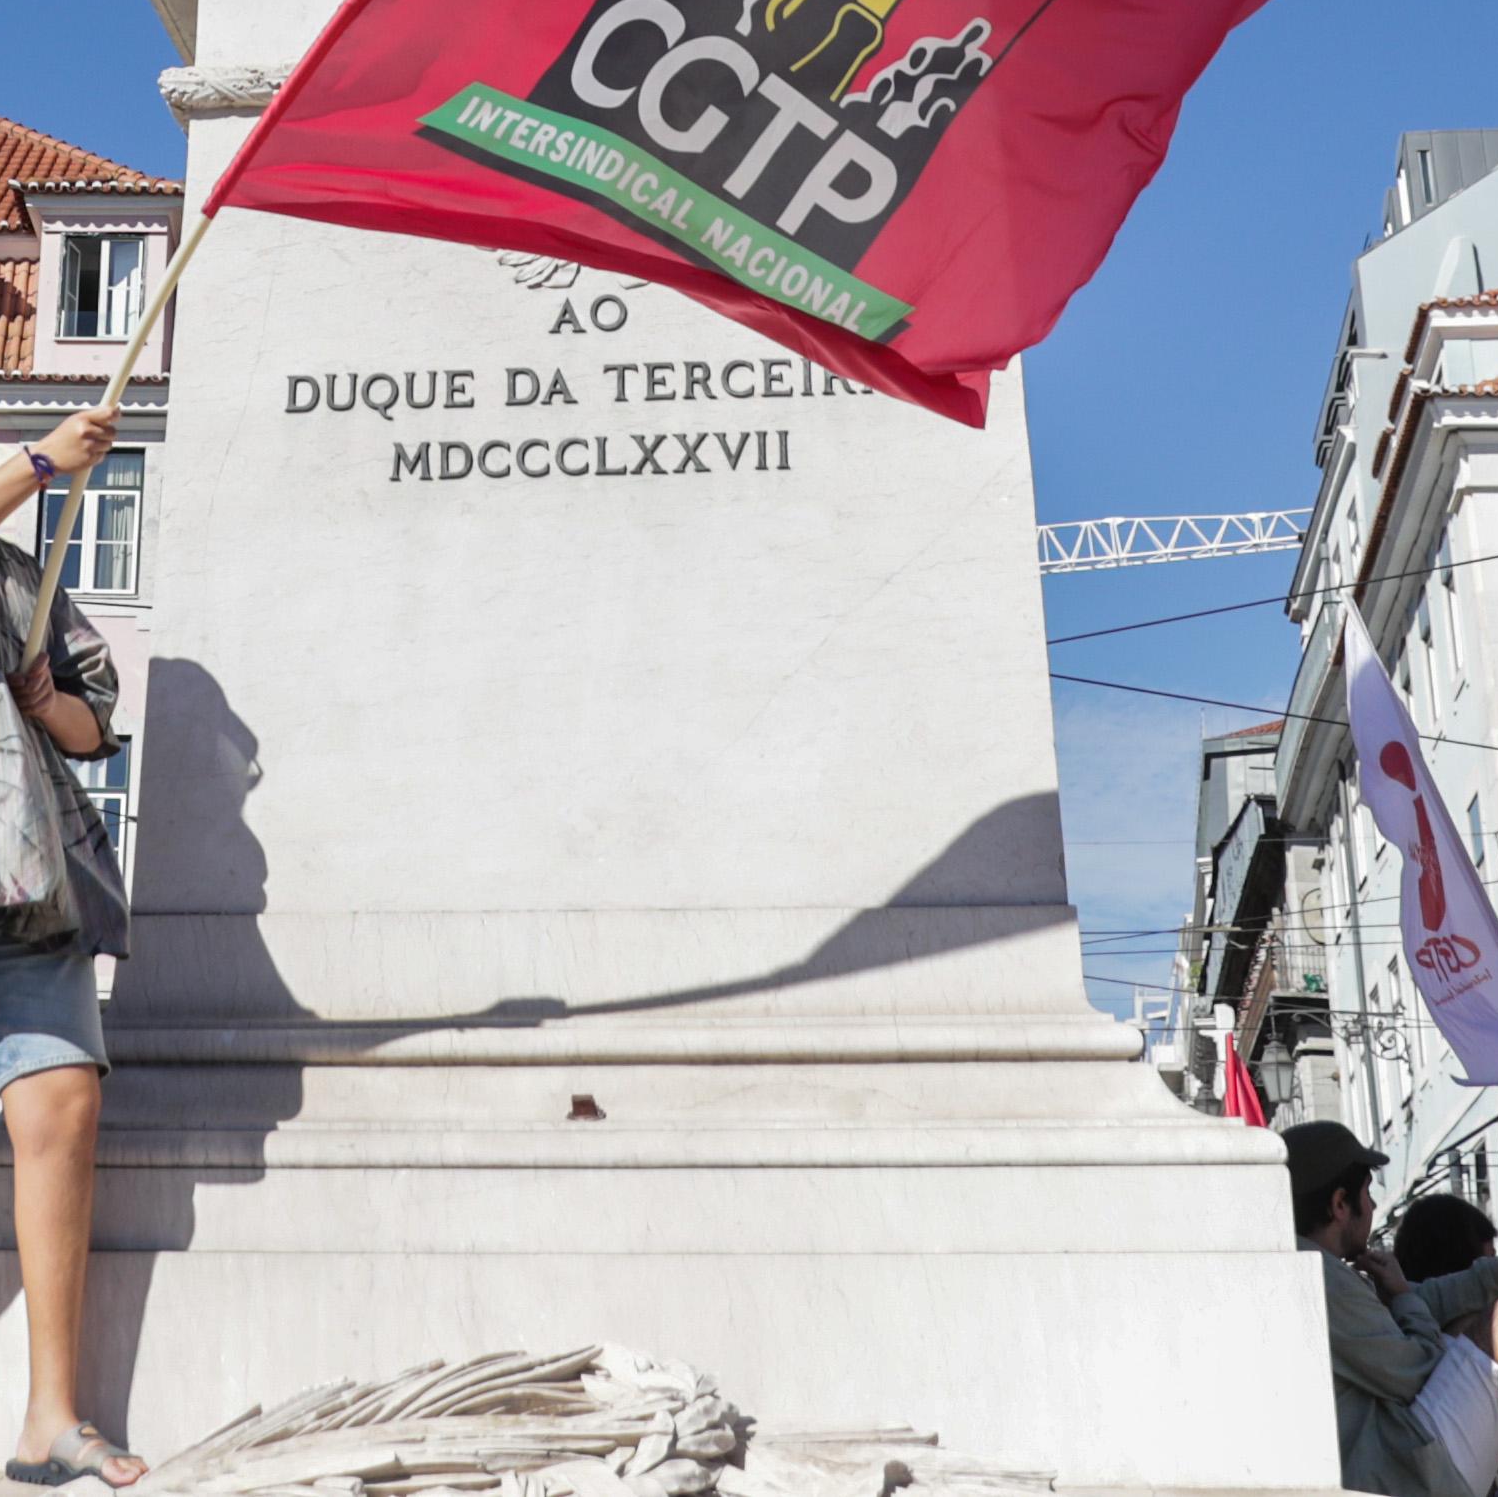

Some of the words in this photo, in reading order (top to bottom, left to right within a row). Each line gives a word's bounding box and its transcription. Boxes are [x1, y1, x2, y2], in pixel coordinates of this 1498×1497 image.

[456, 95, 695, 232] INTERSINDICAL
[699, 216, 871, 333] NACIONAL
[548, 293, 628, 334] AO
[284, 369, 475, 421] DUQUE
[504, 367, 579, 405] DA
[603, 358, 873, 403] TERCEIR
[389, 430, 792, 482] MDCCCLXXVII
